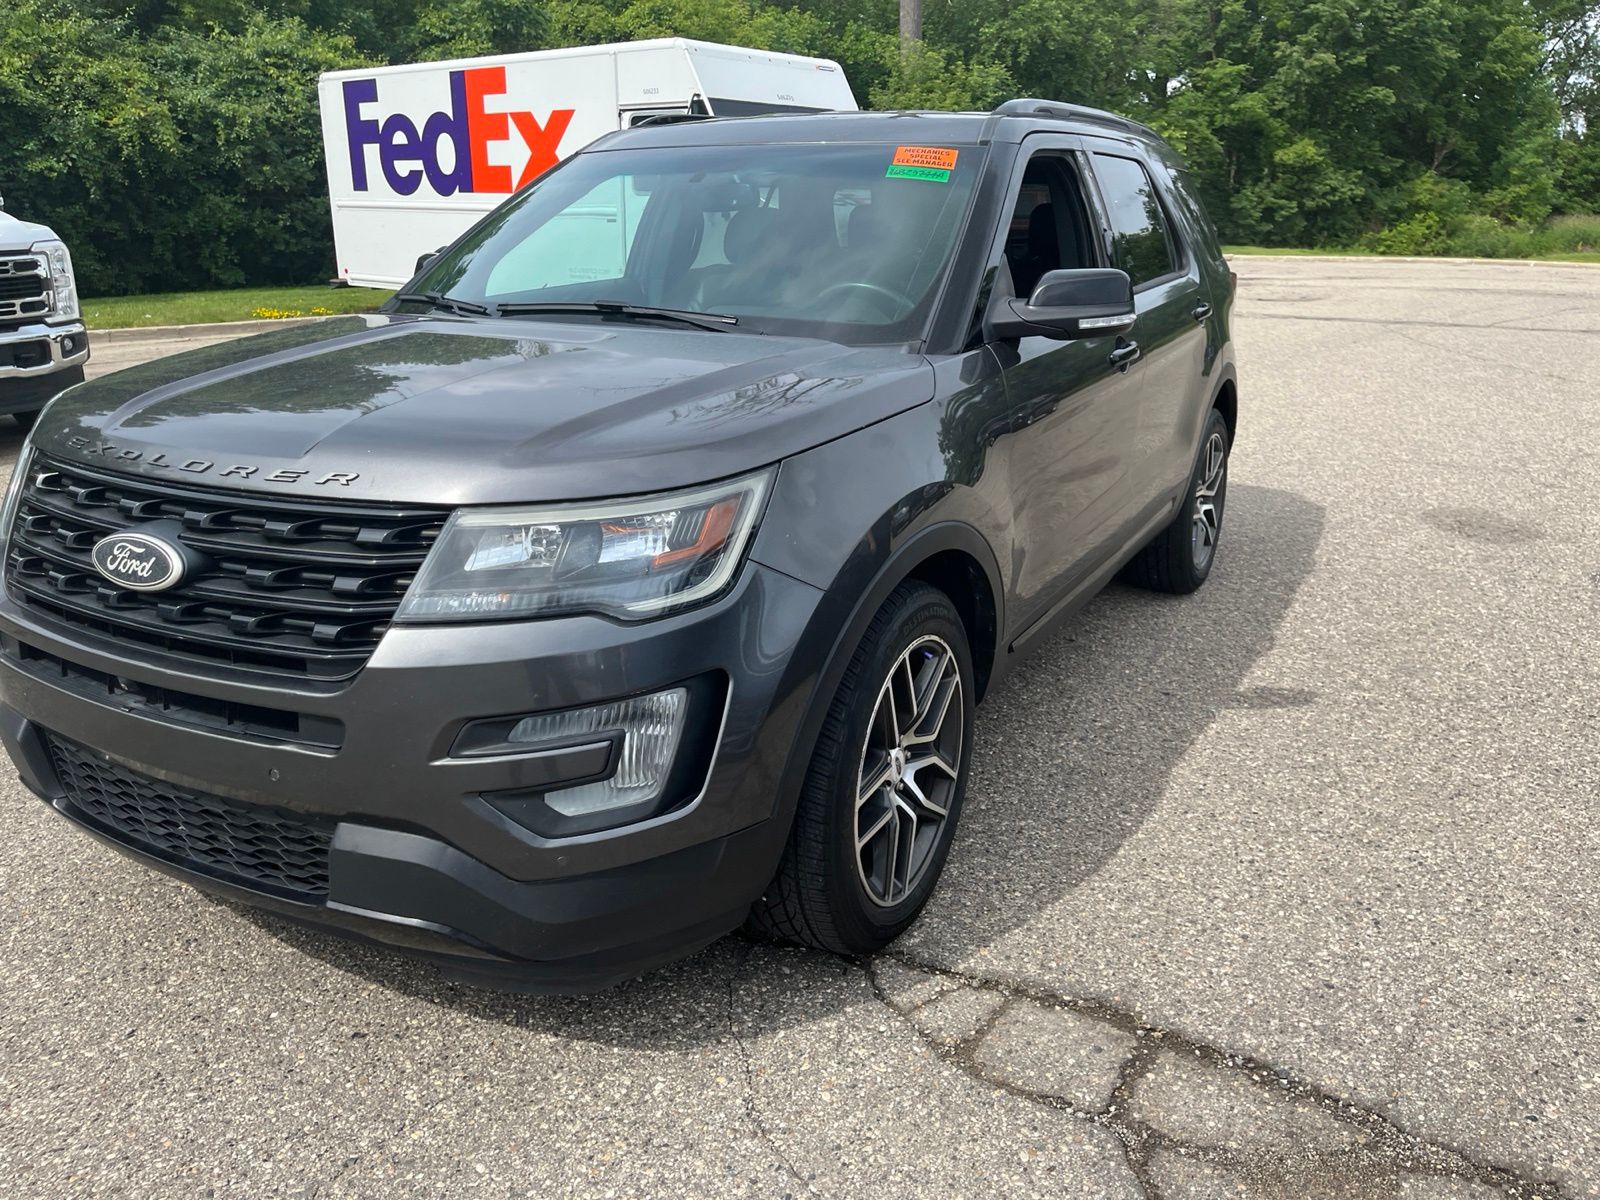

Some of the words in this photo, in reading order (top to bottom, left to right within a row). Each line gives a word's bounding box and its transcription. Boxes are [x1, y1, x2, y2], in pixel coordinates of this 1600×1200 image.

[342, 66, 575, 197] FedEx
[904, 148, 950, 156] MECHANICS
[909, 153, 943, 161] SPECIAL
[912, 159, 953, 168] MANAGER
[66, 436, 360, 487] EXPLORER
[106, 542, 157, 578] Ford
